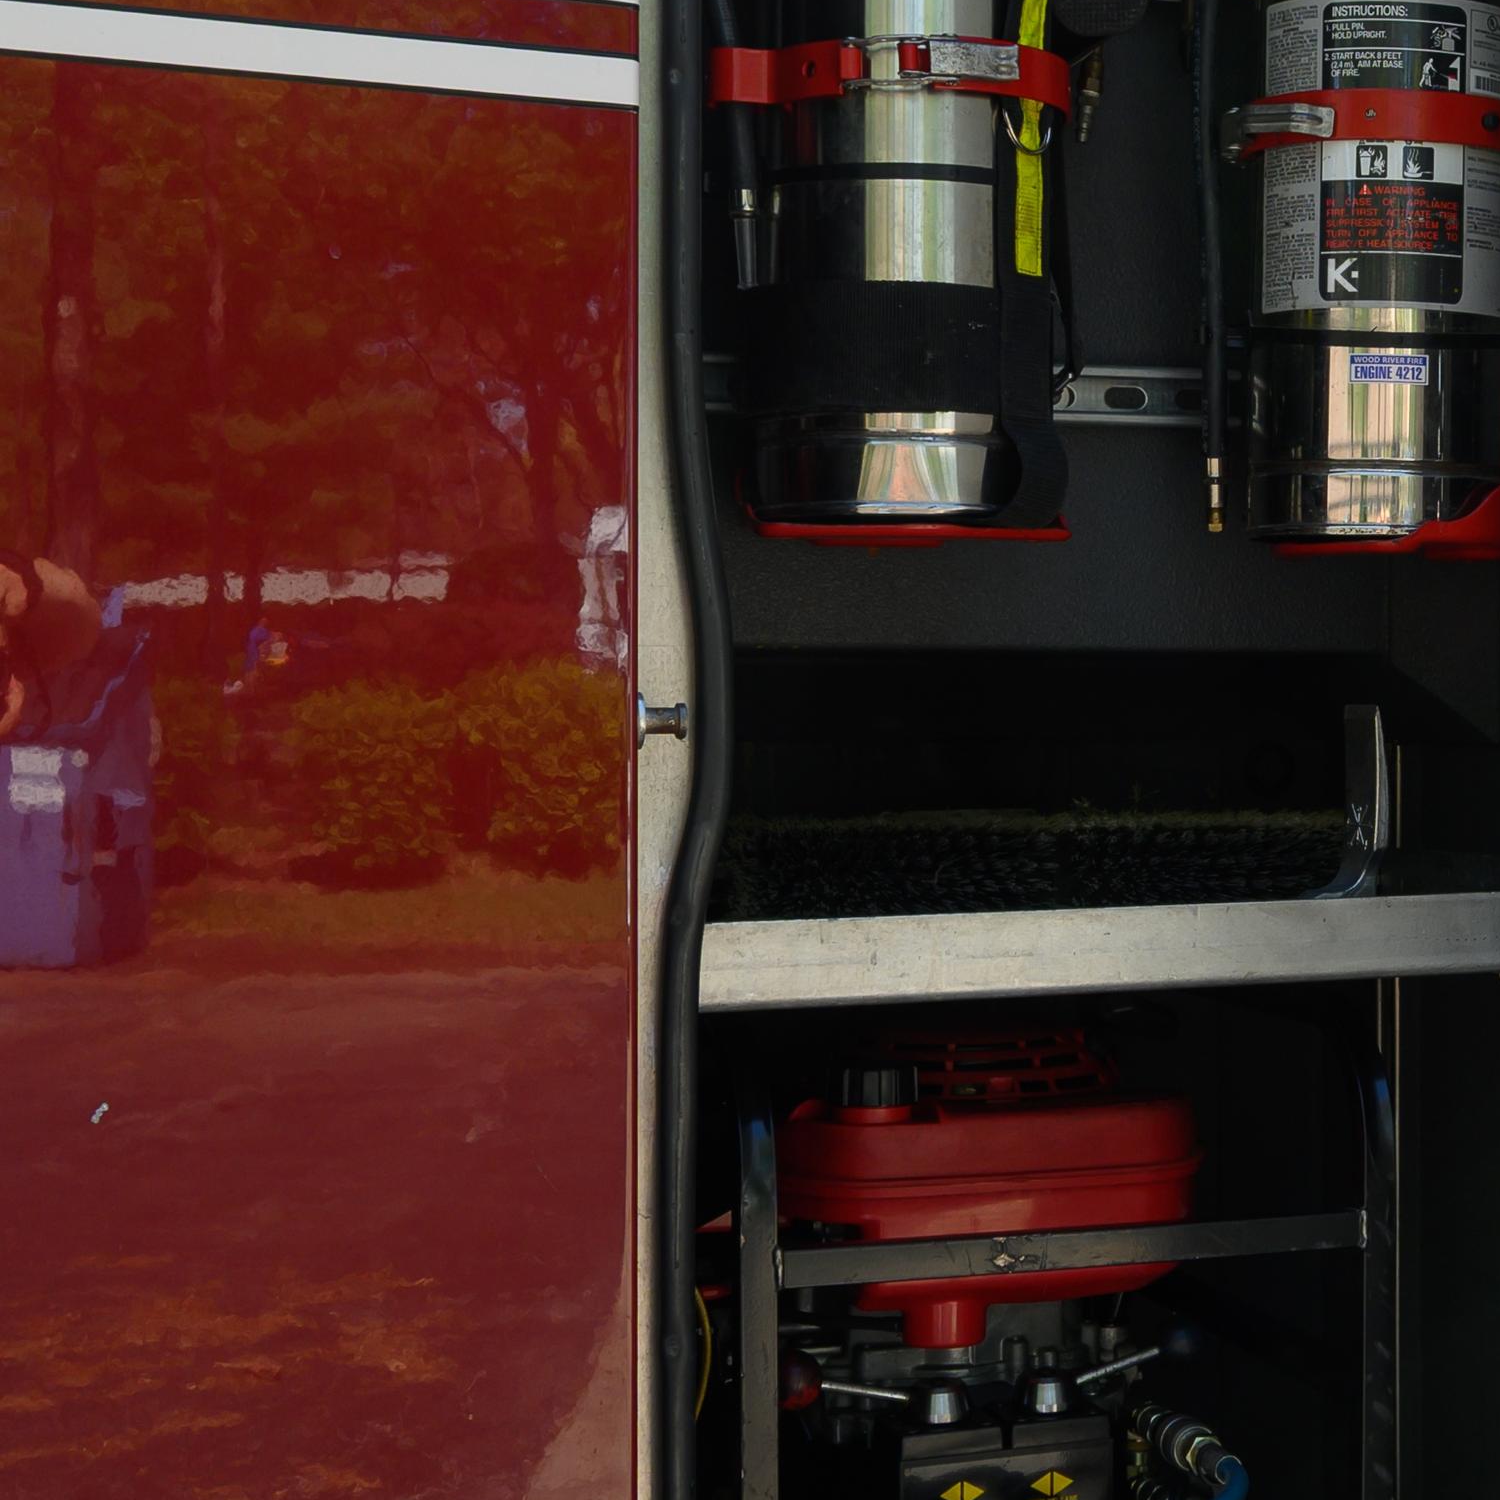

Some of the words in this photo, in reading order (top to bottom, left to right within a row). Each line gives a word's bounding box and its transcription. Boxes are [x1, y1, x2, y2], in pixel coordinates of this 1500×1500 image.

[1331, 4, 1408, 17] INSTRUCTIONS:
[1331, 22, 1350, 30] PULL
[1331, 31, 1351, 39] HOLD
[1353, 30, 1387, 39] UPRIGHT.
[1331, 52, 1353, 60] START
[1355, 52, 1375, 60] BACK
[1383, 52, 1402, 60] FEET
[1357, 60, 1371, 69] AIM
[1371, 60, 1381, 68] AT
[1382, 60, 1403, 69] BASE
[1331, 69, 1341, 77] OF
[1375, 186, 1425, 196] WARNING
[1345, 198, 1372, 207] CASE
[1382, 197, 1396, 206] OF
[1407, 199, 1457, 211] APPLIANCE
[1352, 207, 1378, 216] FIRST
[1326, 229, 1350, 238] TURN
[1358, 228, 1375, 237] OFF
[1385, 229, 1438, 240] APPLIANCE
[1367, 240, 1390, 249] HEAT
[1407, 357, 1424, 365] FIRE
[1354, 366, 1392, 379] ENGINE
[1395, 367, 1422, 380] 4212
